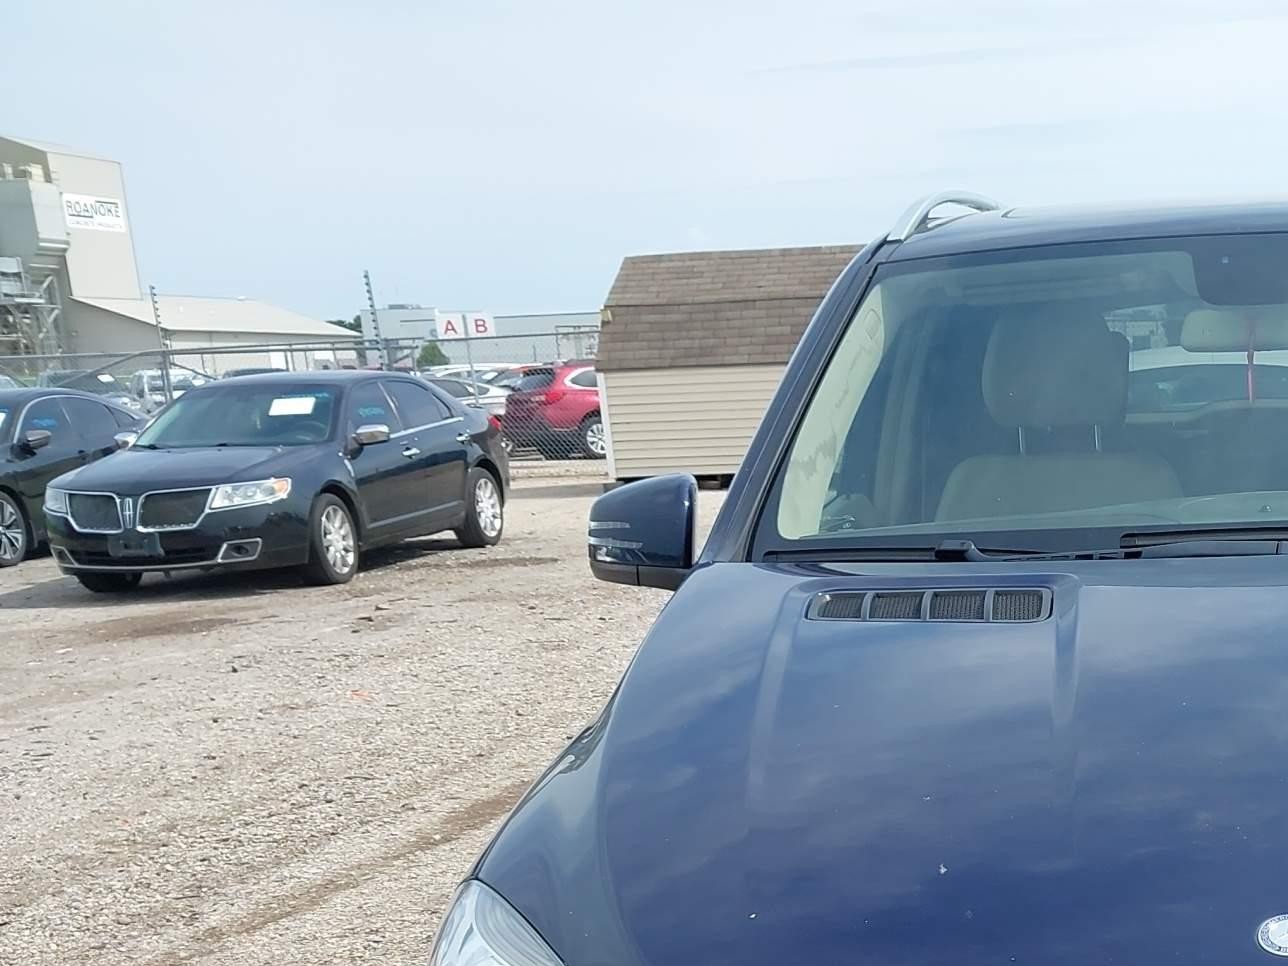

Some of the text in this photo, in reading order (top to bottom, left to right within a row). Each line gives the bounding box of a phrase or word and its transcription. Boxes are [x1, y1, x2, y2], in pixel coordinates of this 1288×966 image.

[65, 200, 120, 218] ROANOKE
[444, 319, 488, 335] A B
